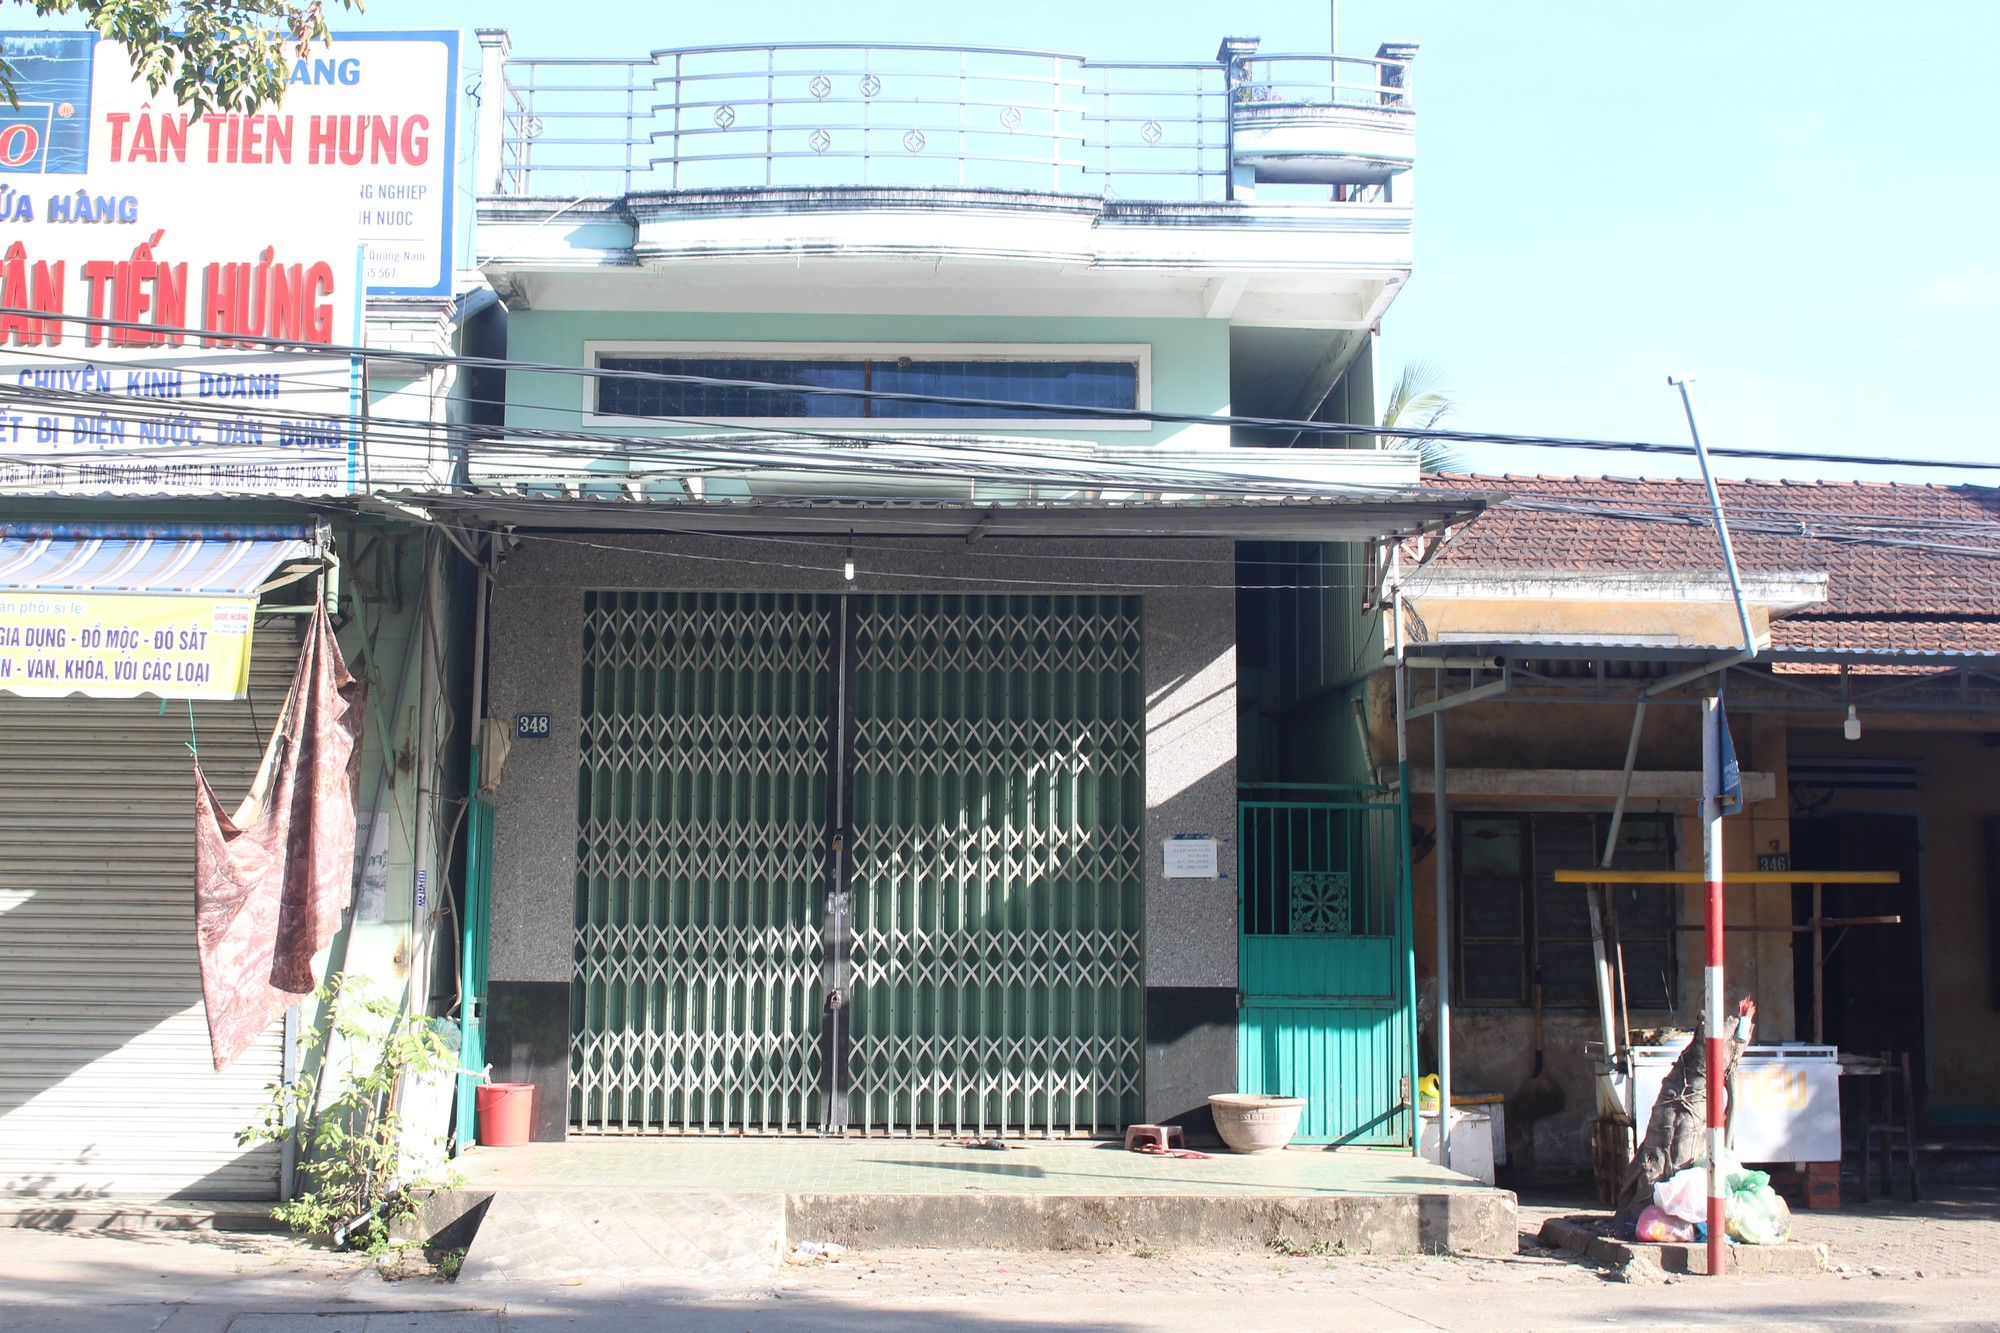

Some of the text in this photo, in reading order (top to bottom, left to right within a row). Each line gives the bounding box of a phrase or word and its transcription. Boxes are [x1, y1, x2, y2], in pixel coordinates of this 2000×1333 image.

[106, 102, 188, 163] TÂN
[308, 114, 429, 166] HƯNG
[49, 189, 139, 223] HÀNG
[359, 211, 371, 225] H
[403, 251, 425, 261] Nam
[0, 229, 334, 347] ÂN TIẾN HƯNG
[379, 268, 396, 278] 567
[18, 364, 280, 400] CHUYÊN KINH DOANH
[37, 416, 59, 449] BỊ
[74, 411, 125, 450] ĐIỆN
[217, 413, 263, 445] DÂN
[280, 418, 342, 453] DỤNG
[25, 628, 66, 652] DỤNG
[106, 625, 139, 653] MỘC
[179, 624, 207, 650] SẮT
[27, 659, 59, 681] VAN,
[64, 656, 108, 682] KHÓA,
[114, 656, 138, 681] VÒI
[143, 658, 172, 681] CÁC
[176, 662, 210, 687] LOẠI
[520, 716, 548, 733] 348
[1760, 856, 1786, 872] 346
